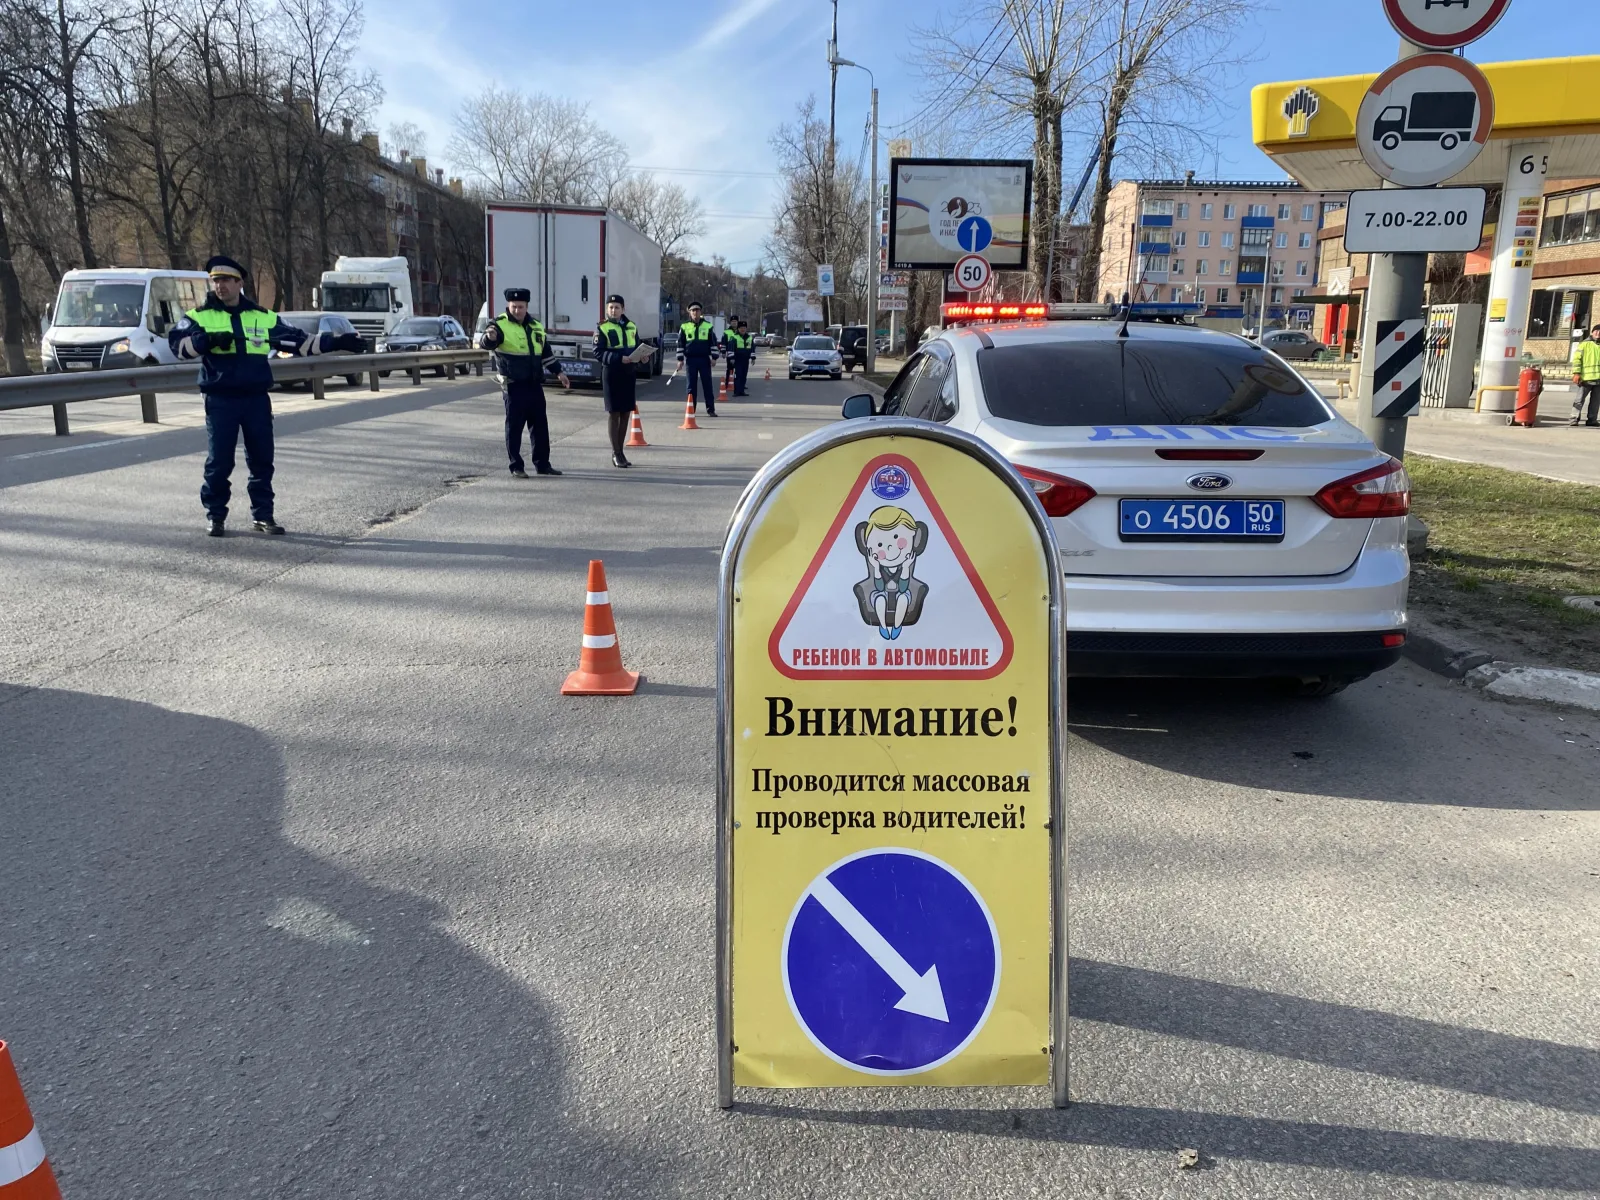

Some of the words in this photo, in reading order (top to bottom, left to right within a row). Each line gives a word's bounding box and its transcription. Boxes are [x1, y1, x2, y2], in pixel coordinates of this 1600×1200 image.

[1519, 155, 1534, 174] 6
[940, 219, 951, 228] ГОД
[1365, 210, 1467, 228] 7.00-22.00
[944, 229, 956, 237] НАС
[963, 266, 981, 281] 50
[1087, 425, 1300, 441] ДПС
[1197, 476, 1223, 489] Ford
[1163, 504, 1231, 530] 4506
[1248, 503, 1274, 523] 50
[1251, 523, 1271, 532] RUS
[792, 648, 861, 666] РЕБЕНОК
[867, 648, 877, 666] В
[884, 648, 989, 666] АВТОМОБИЛЕ
[764, 696, 1018, 737] Внимание!
[751, 768, 906, 798] Проводится
[912, 774, 1031, 793] массовая
[756, 810, 876, 835] проверка
[883, 804, 1026, 833] водителей!
